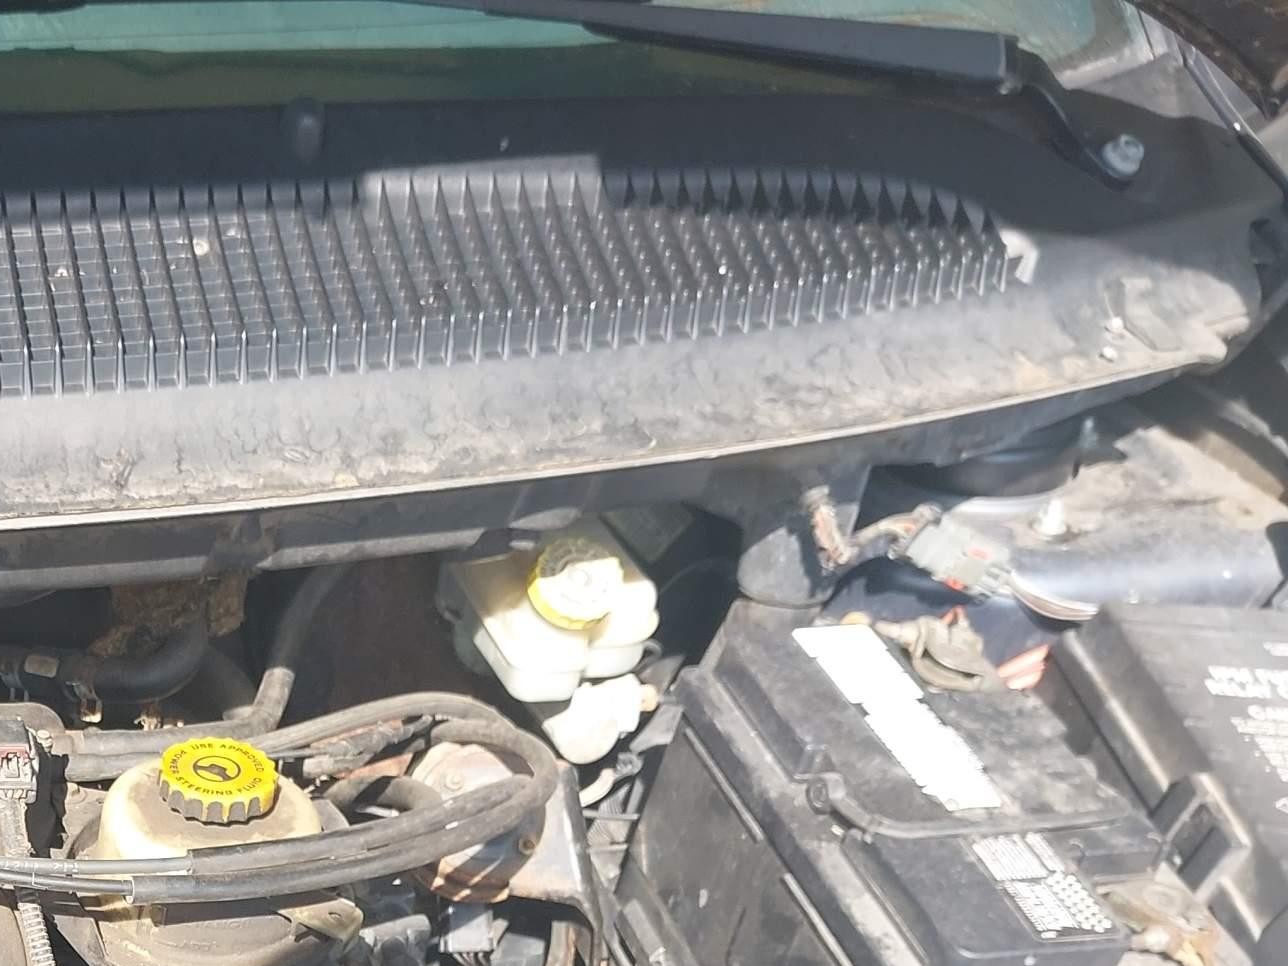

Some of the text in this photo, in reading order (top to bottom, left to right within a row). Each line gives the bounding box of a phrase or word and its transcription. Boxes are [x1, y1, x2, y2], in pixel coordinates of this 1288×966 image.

[169, 749, 262, 796] POWER STEERING FLUID
[191, 742, 265, 774] USE APPROVED
